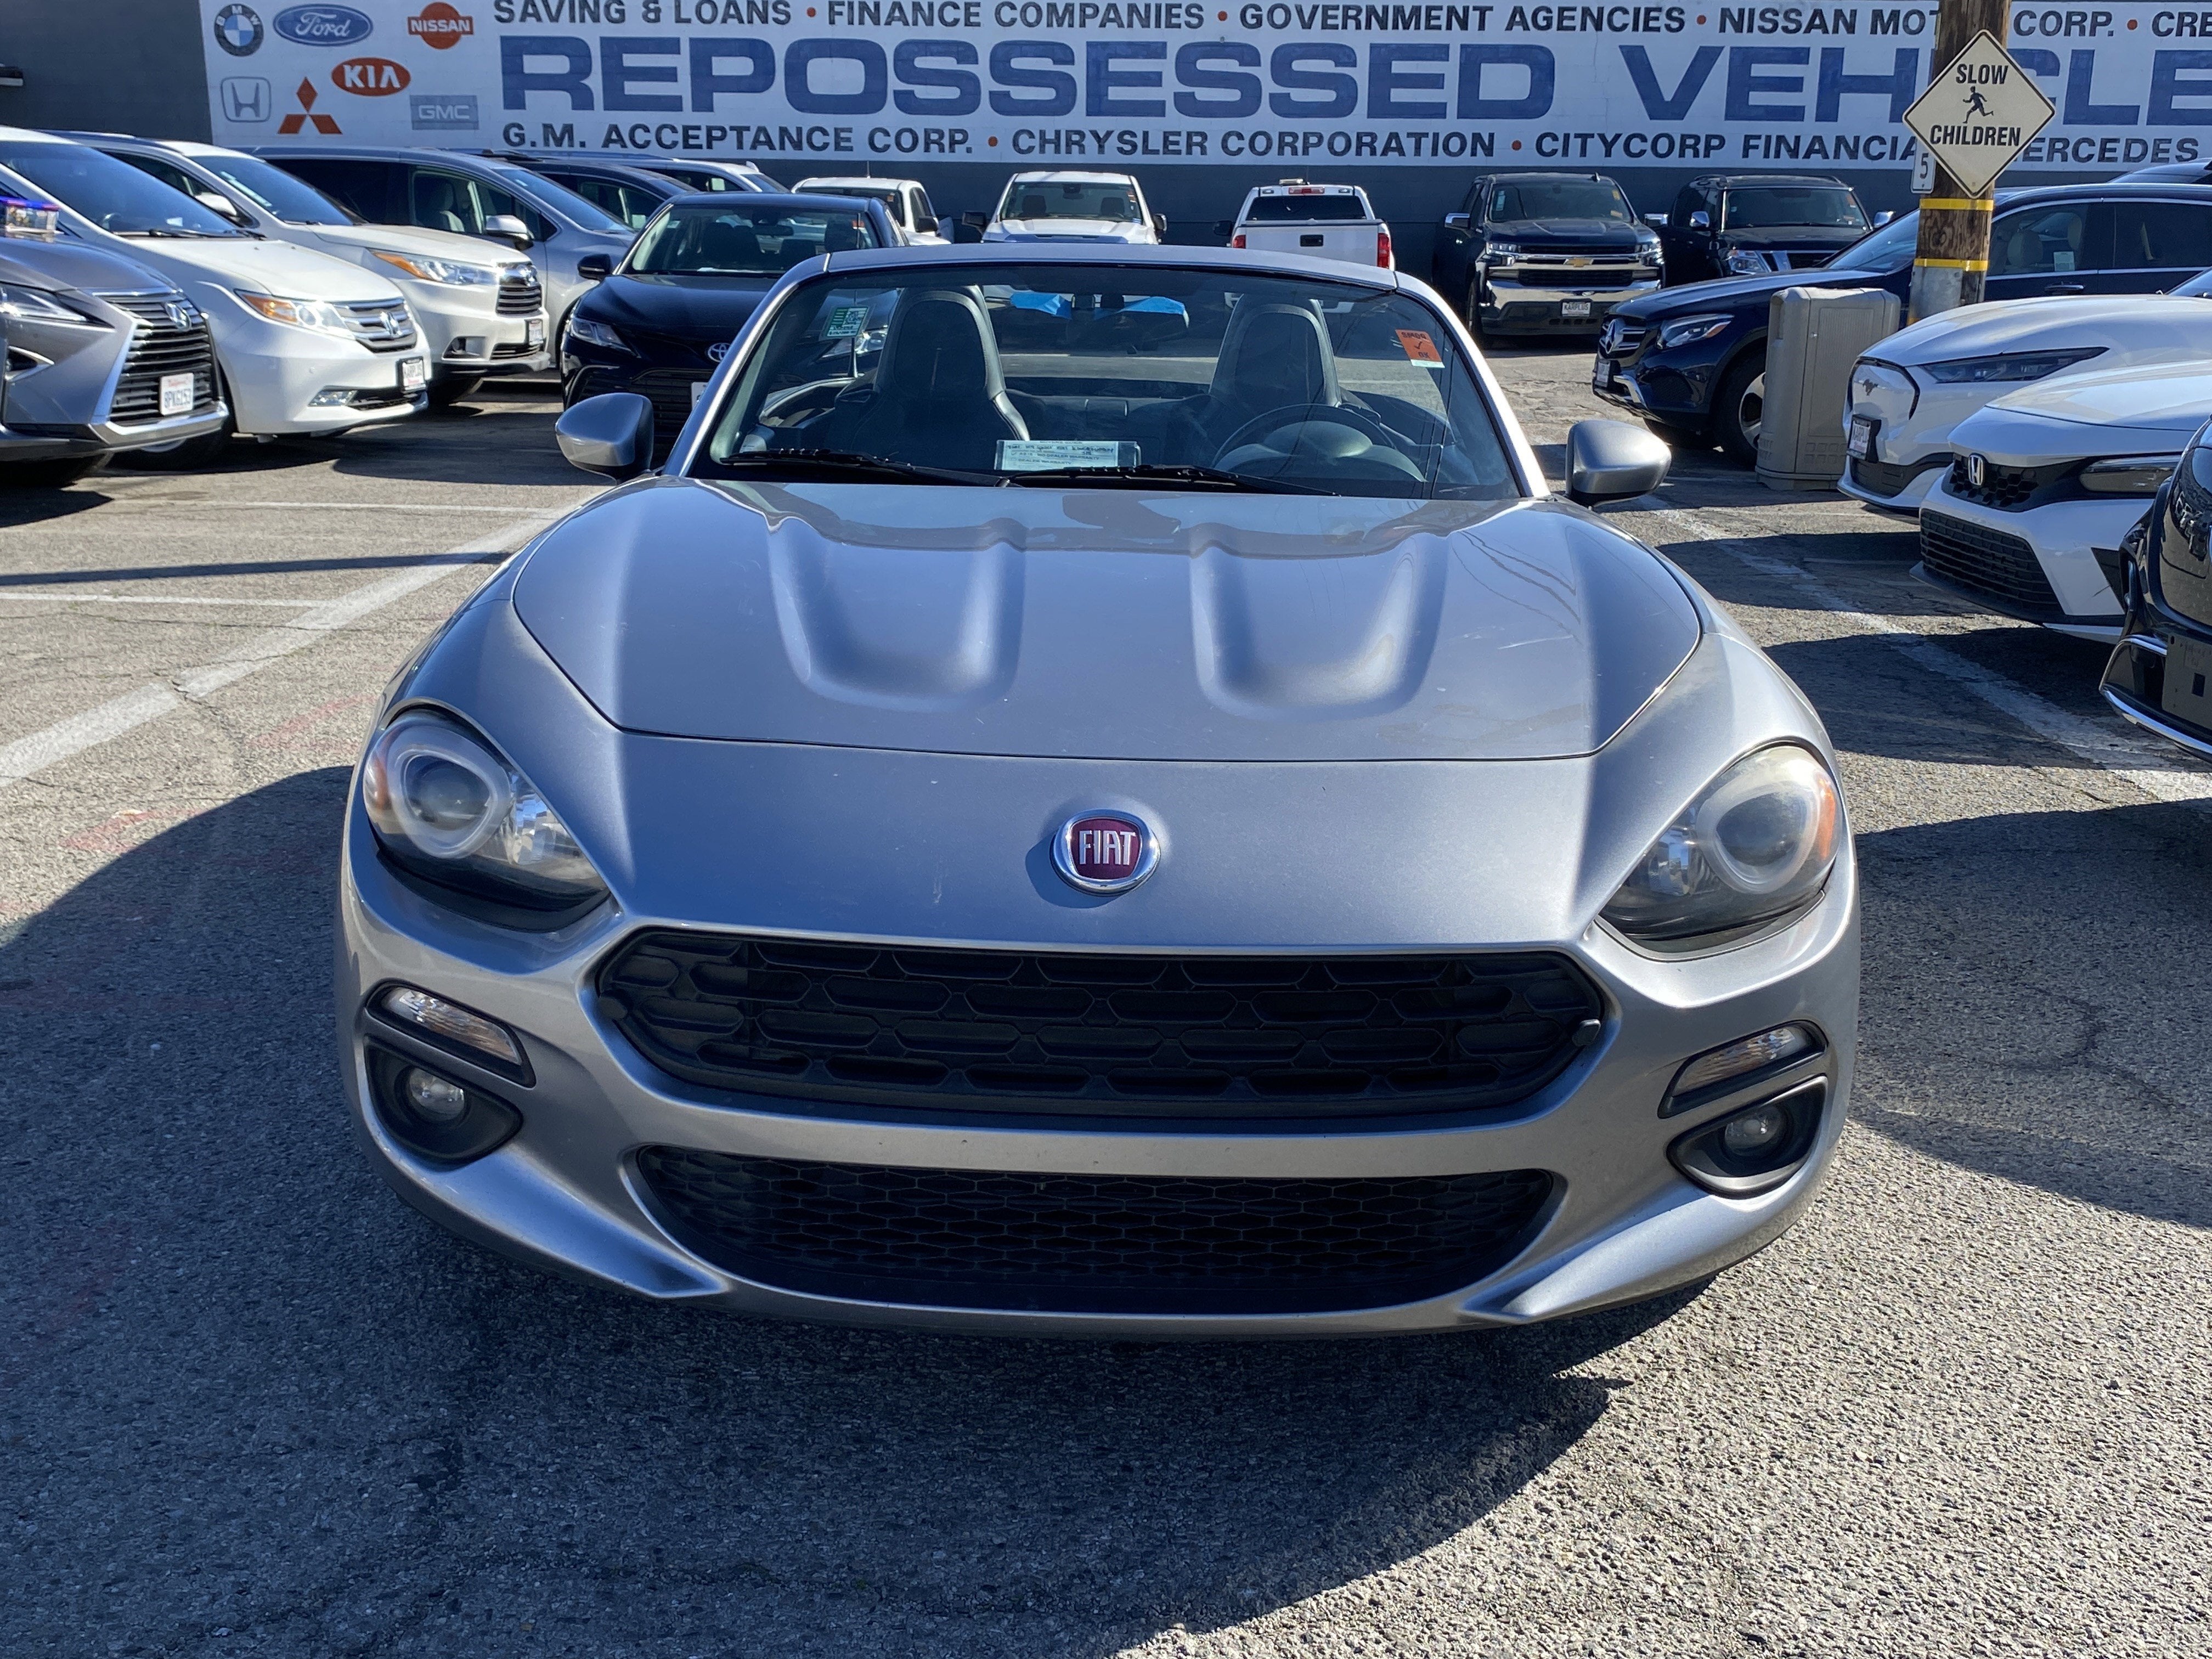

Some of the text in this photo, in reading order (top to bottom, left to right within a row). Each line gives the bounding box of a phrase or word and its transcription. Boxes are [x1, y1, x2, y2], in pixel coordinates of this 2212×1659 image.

[295, 12, 351, 37] Ford
[410, 19, 471, 33] NISSAN
[494, 0, 625, 24] SAVING
[642, 0, 662, 24] &
[674, 0, 791, 25] LOANS
[828, 0, 981, 27] FINANCE
[994, 2, 1204, 30] COMPANIES
[1240, 3, 1494, 31] GOVERNMENT
[1505, 6, 1686, 33] AGENCIES
[1719, 7, 1858, 35] NISSAN
[2013, 10, 2114, 37] CORP.
[343, 65, 400, 89] KIA
[500, 35, 1555, 120] REPOSSESSED
[1955, 64, 2008, 84] SLOW
[418, 104, 471, 120] GMC
[503, 122, 2199, 163] G.M. ACCEPTANCE CORP. CHRYSLER CORPORATION CITYCORP FINANCIA ERCEDES
[1929, 125, 2021, 146] CHILDREN
[1920, 153, 1929, 179] 5
[1079, 830, 1137, 866] FIAT
